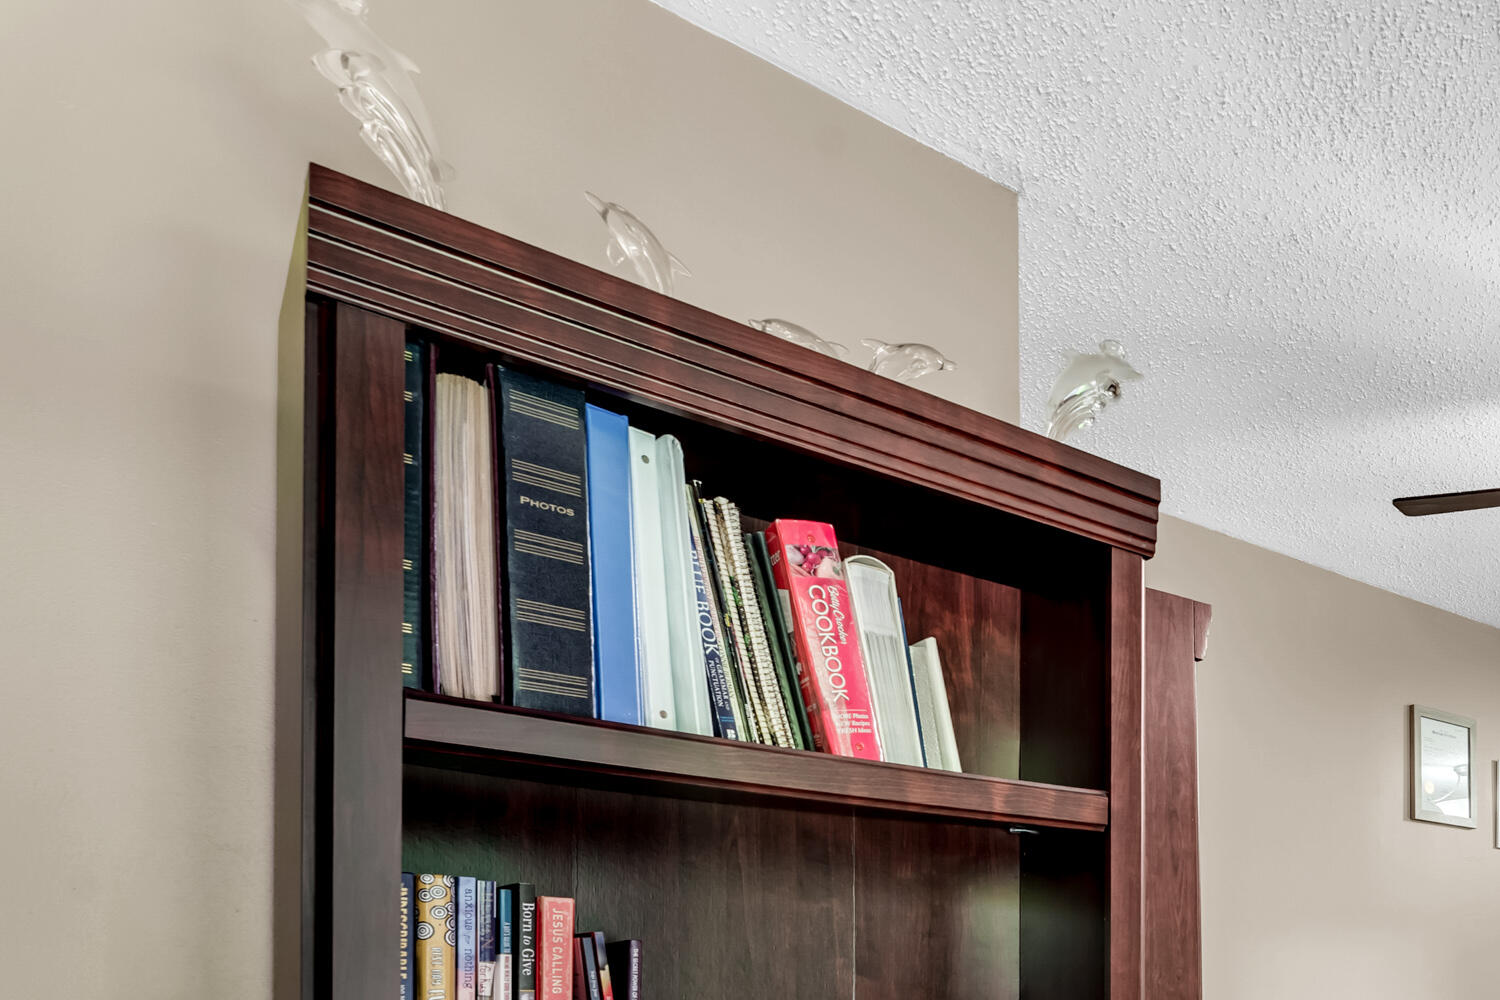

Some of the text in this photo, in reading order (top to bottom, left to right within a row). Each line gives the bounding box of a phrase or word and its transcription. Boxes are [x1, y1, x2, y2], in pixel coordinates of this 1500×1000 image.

[519, 495, 576, 517] PHOTOS
[697, 601, 720, 657] BOOK
[808, 584, 849, 701] COOKBOOK
[827, 584, 848, 645] Betty Crocker
[715, 664, 728, 701] GRAMMAR
[462, 888, 474, 989] anxious nothing
[522, 902, 535, 976] Born to Give
[551, 908, 564, 994] JESUS CALLING
